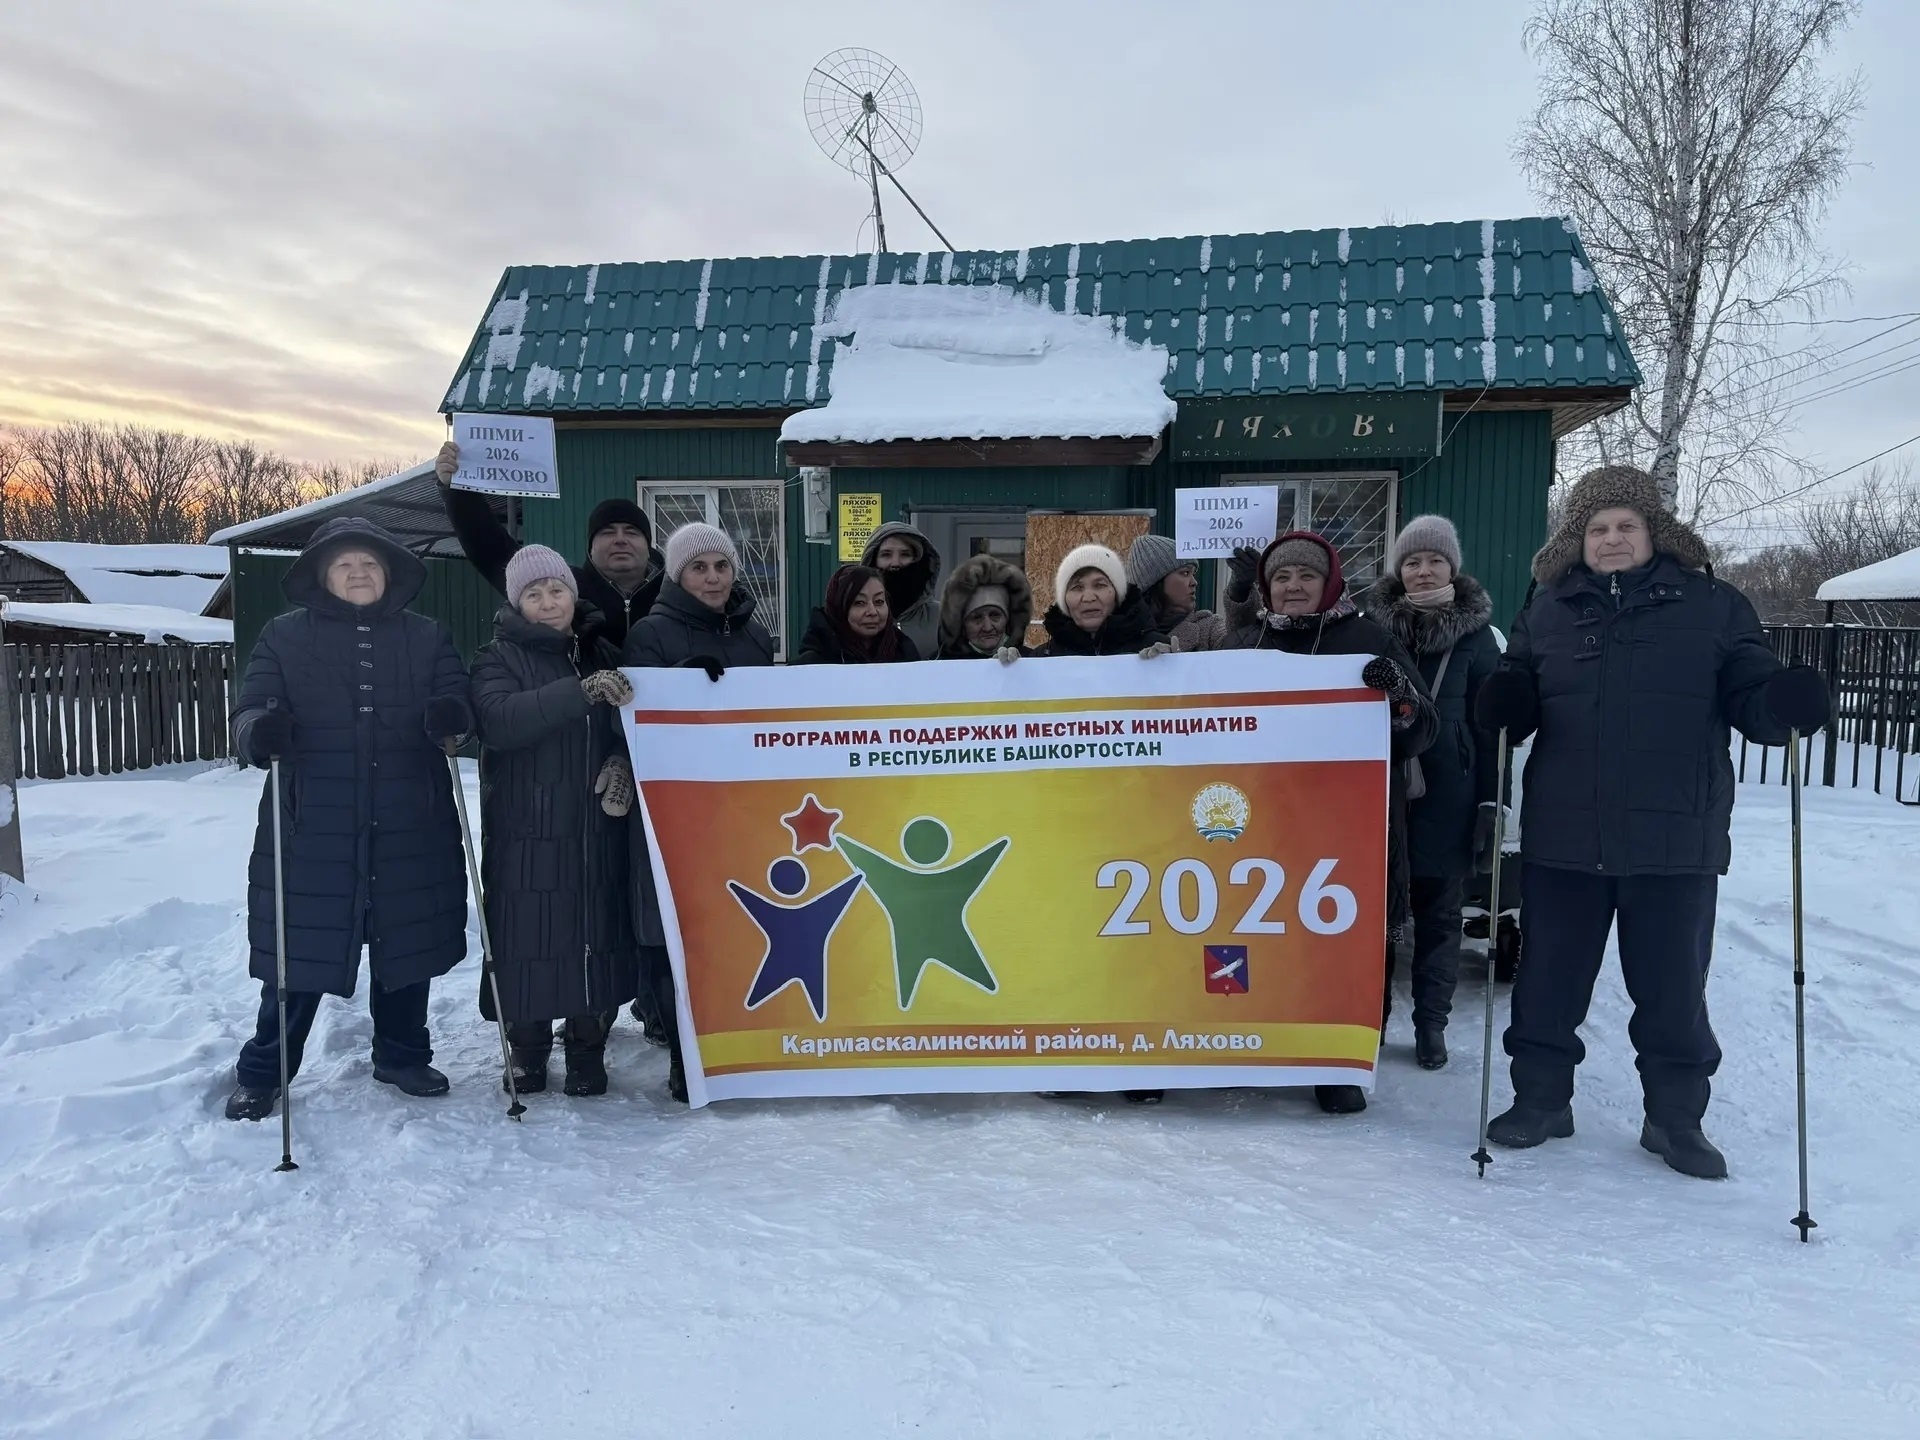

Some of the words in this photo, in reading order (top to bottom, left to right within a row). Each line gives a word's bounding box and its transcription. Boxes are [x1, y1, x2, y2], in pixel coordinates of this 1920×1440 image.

[469, 427, 524, 442] ППМИ
[1197, 413, 1396, 439] ЛЯХОВ
[485, 447, 519, 462] 2026
[458, 467, 548, 483] д.ЛЯХОВО
[1194, 498, 1249, 511] ППМИ
[1209, 517, 1243, 530] 2026
[754, 729, 882, 748] ПРОГРАММА
[889, 724, 1017, 745] ПОДДЕРЖКИ
[1025, 720, 1125, 739] МЕСТНЫХ
[1131, 716, 1258, 736] ИНИЦИАТИВ
[849, 752, 861, 767] В
[868, 747, 996, 766] РЕСПУБЛИКЕ
[1003, 741, 1162, 762] БАШКОРТОСТАН
[1095, 857, 1358, 937] 2026
[782, 1029, 1027, 1057] Кармаскалинский
[1035, 1027, 1125, 1054] район,
[1132, 1034, 1155, 1052] д.
[1162, 1029, 1262, 1050] Ляхово
